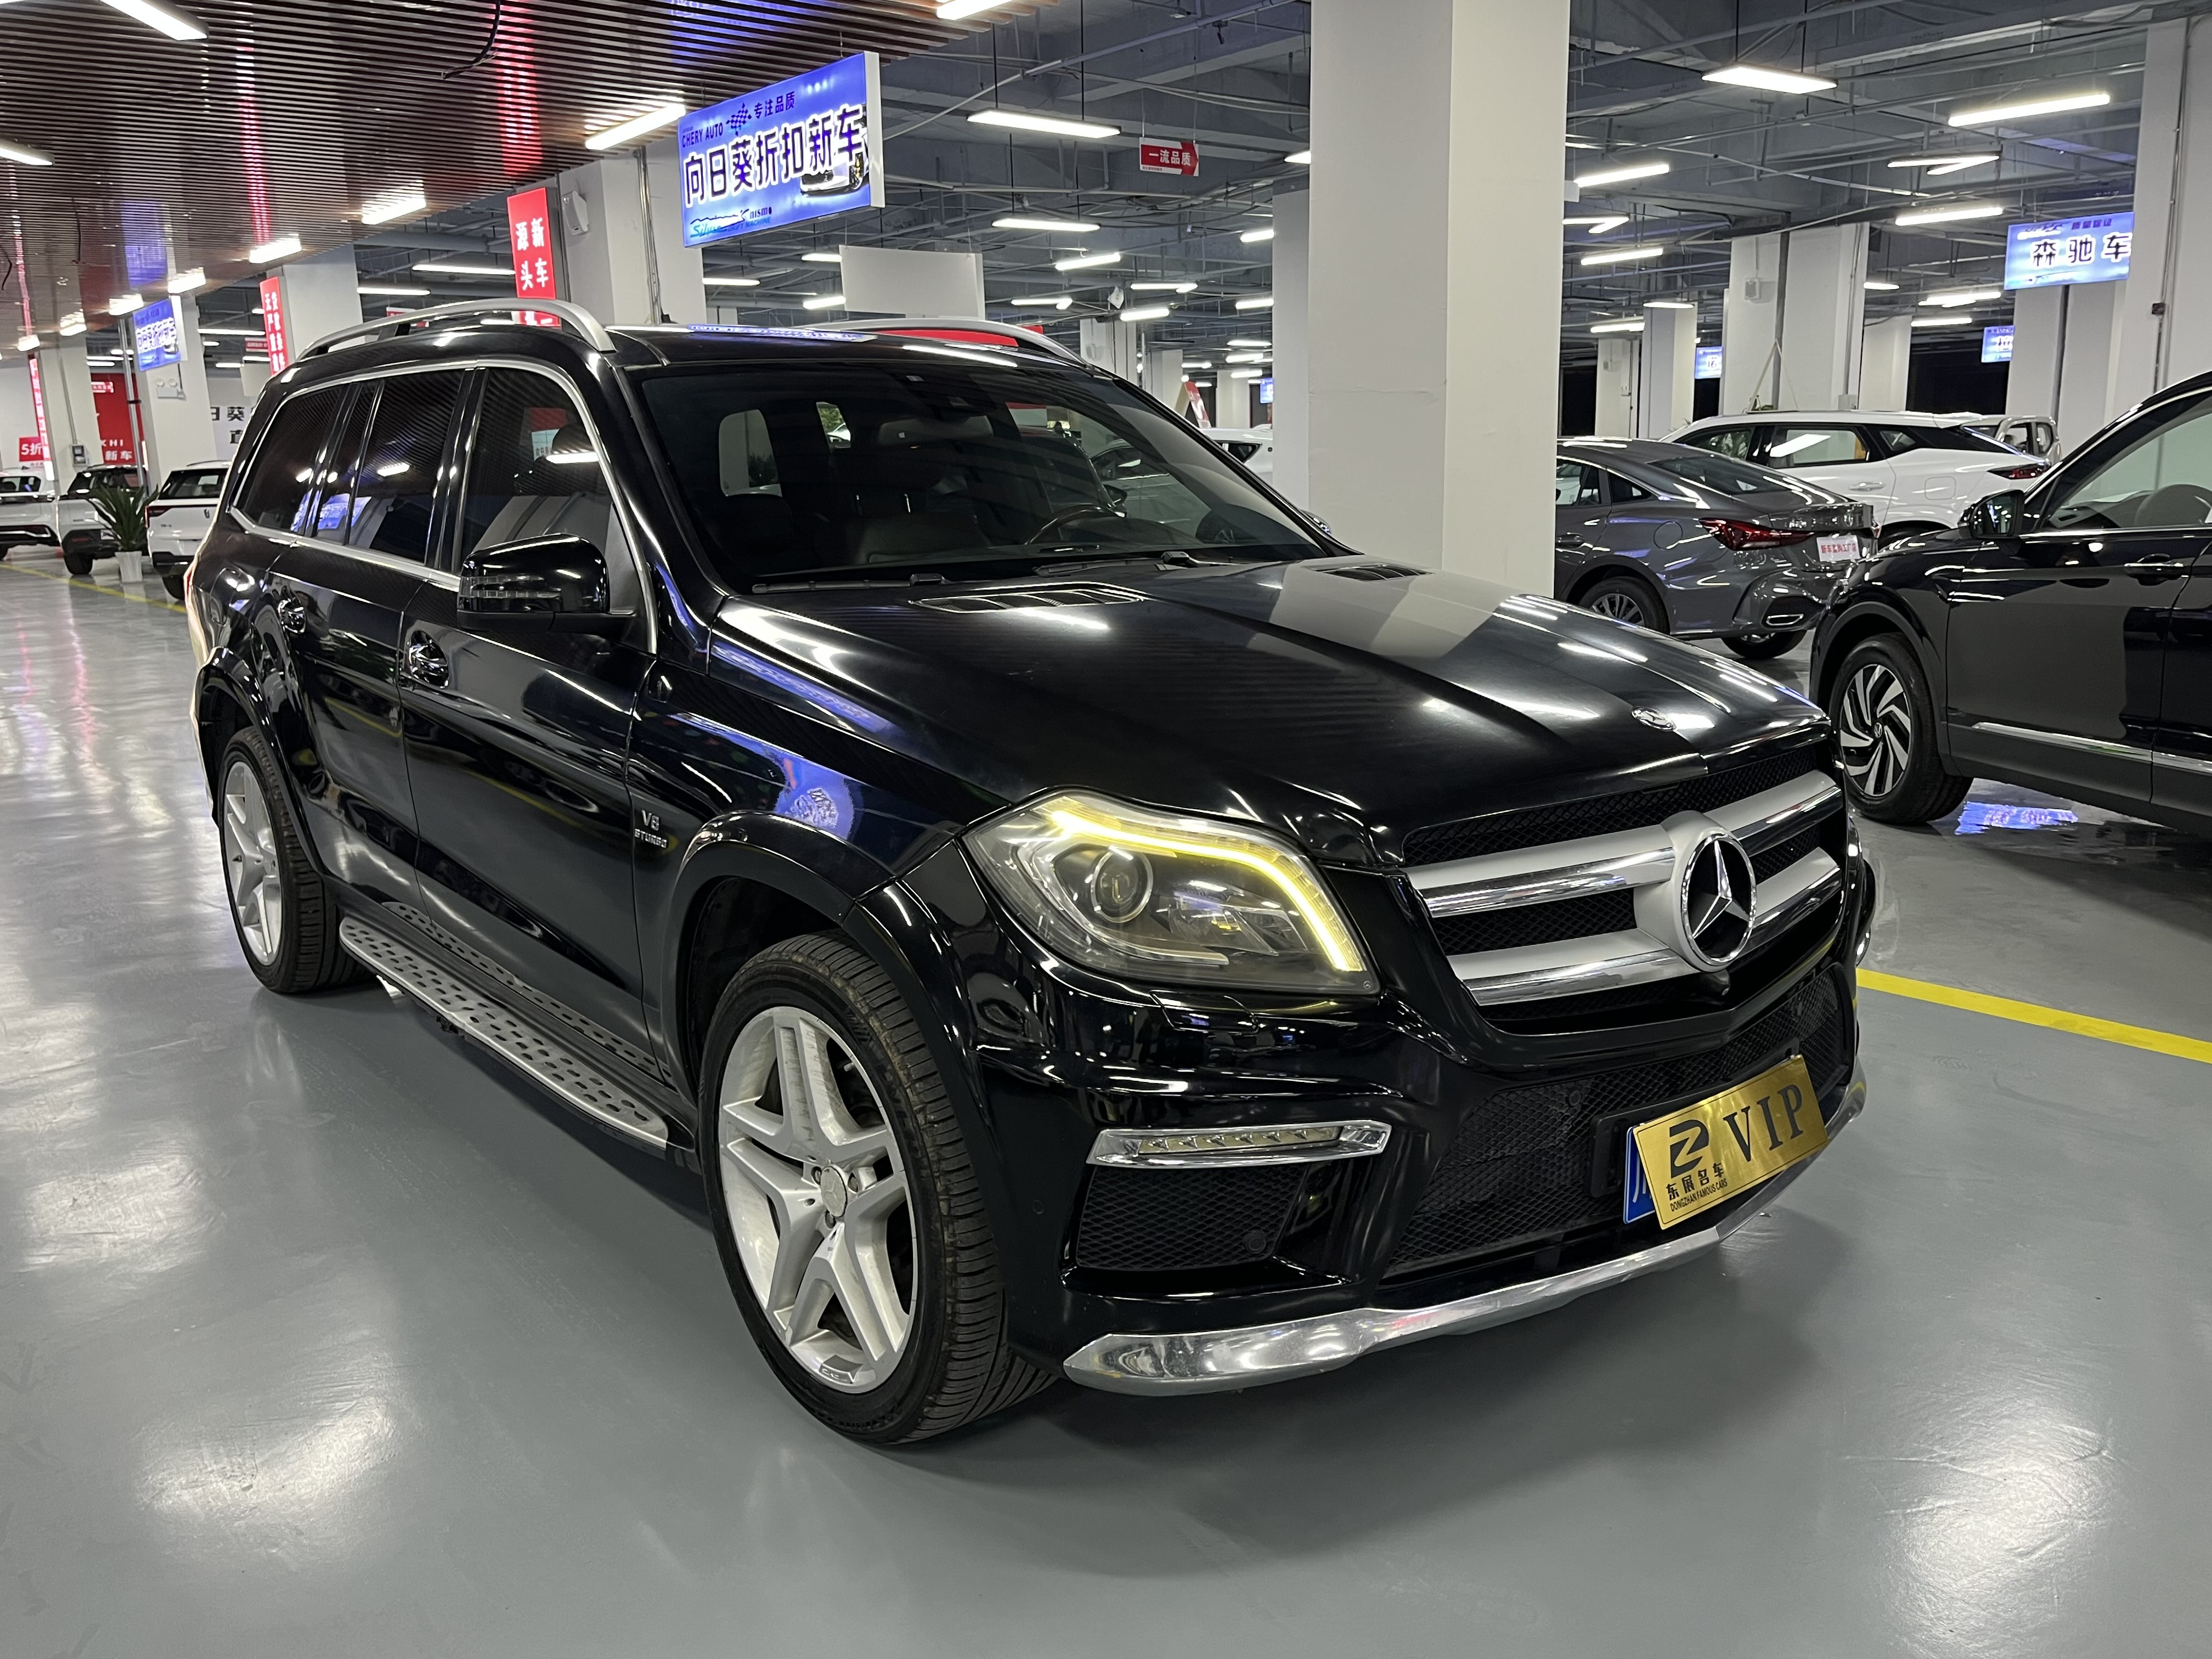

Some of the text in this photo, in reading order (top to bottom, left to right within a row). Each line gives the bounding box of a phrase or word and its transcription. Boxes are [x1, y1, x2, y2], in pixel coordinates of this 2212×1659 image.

[754, 91, 795, 119] 专注品质
[682, 122, 724, 148] CHERY AUTO
[685, 108, 864, 205] 向日葵折扣新车
[1148, 149, 1191, 166] 一流品质
[641, 809, 659, 831] V8
[1723, 1084, 1804, 1162] VIP
[1666, 1163, 1725, 1201] 东展名车
[1670, 1178, 1728, 1212] DONGZHAN FAMOUS CARS
